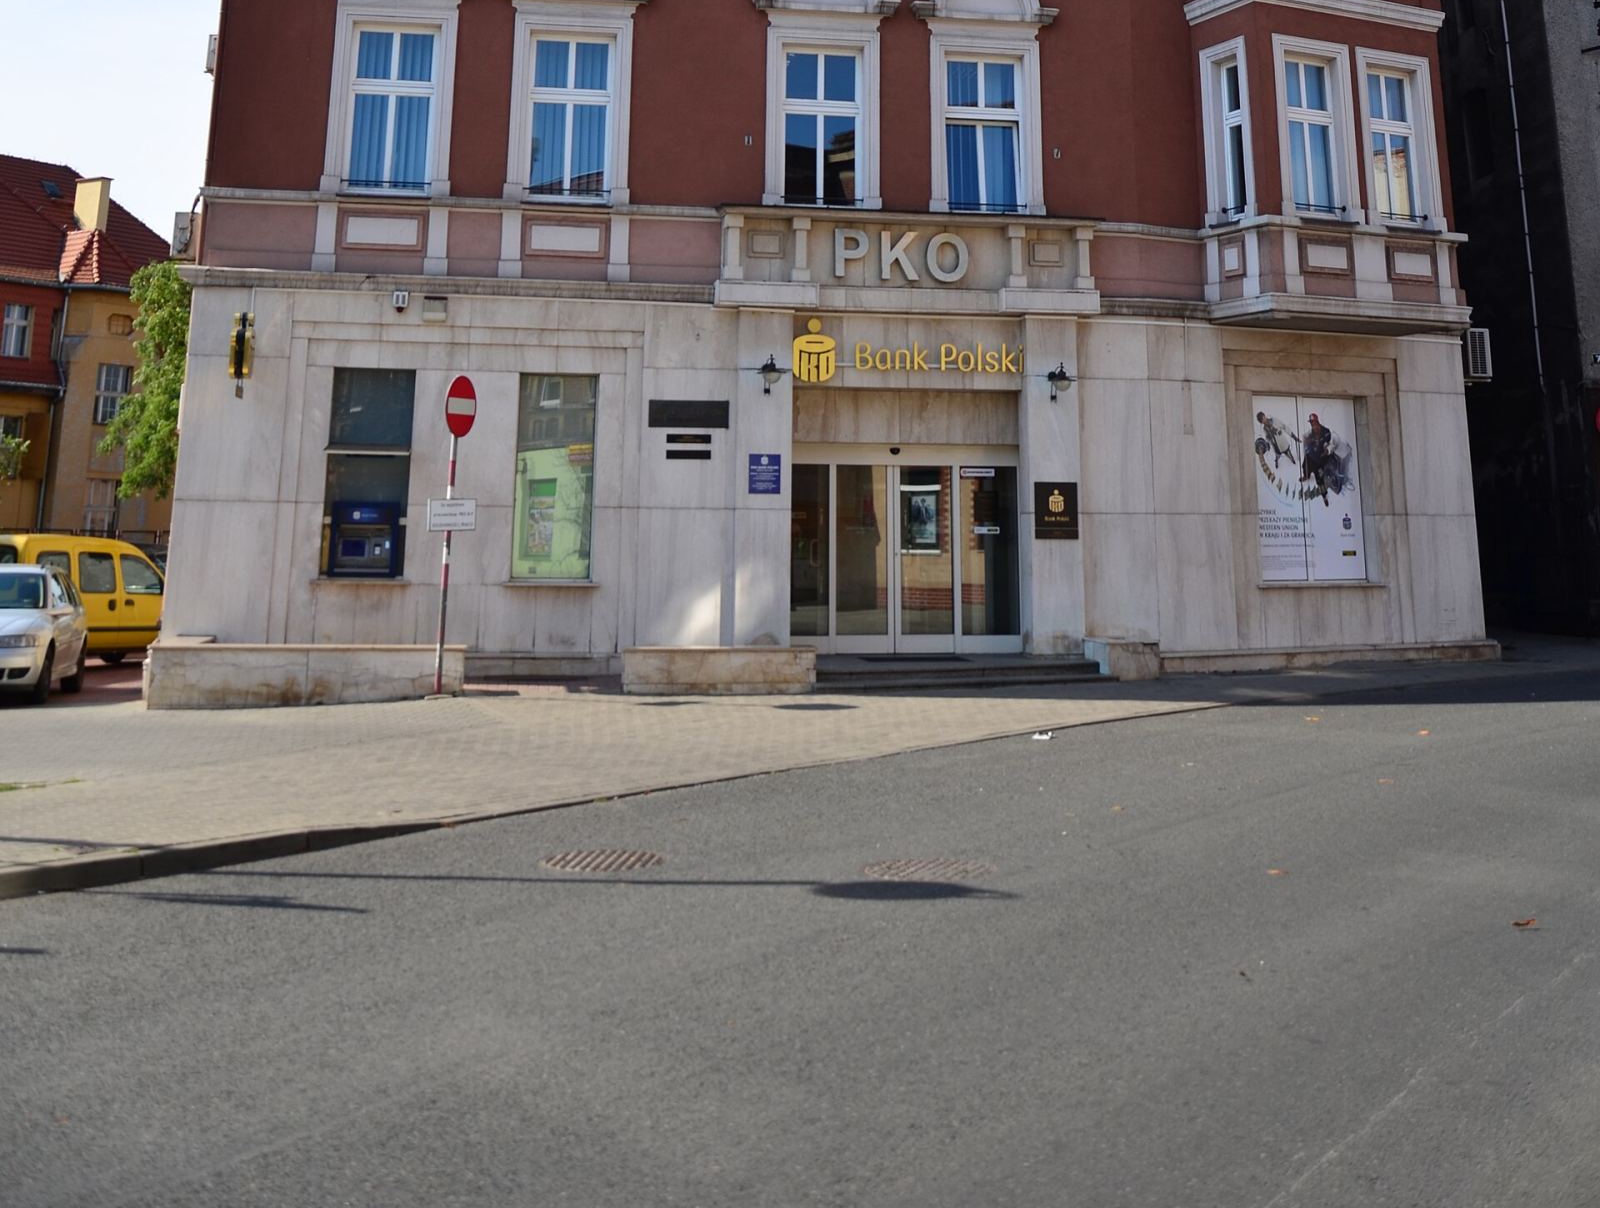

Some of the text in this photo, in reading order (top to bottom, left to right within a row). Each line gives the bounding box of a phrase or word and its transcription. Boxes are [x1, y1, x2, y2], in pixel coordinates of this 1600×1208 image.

[834, 228, 969, 283] PKO
[855, 342, 1025, 374] Bank Polski
